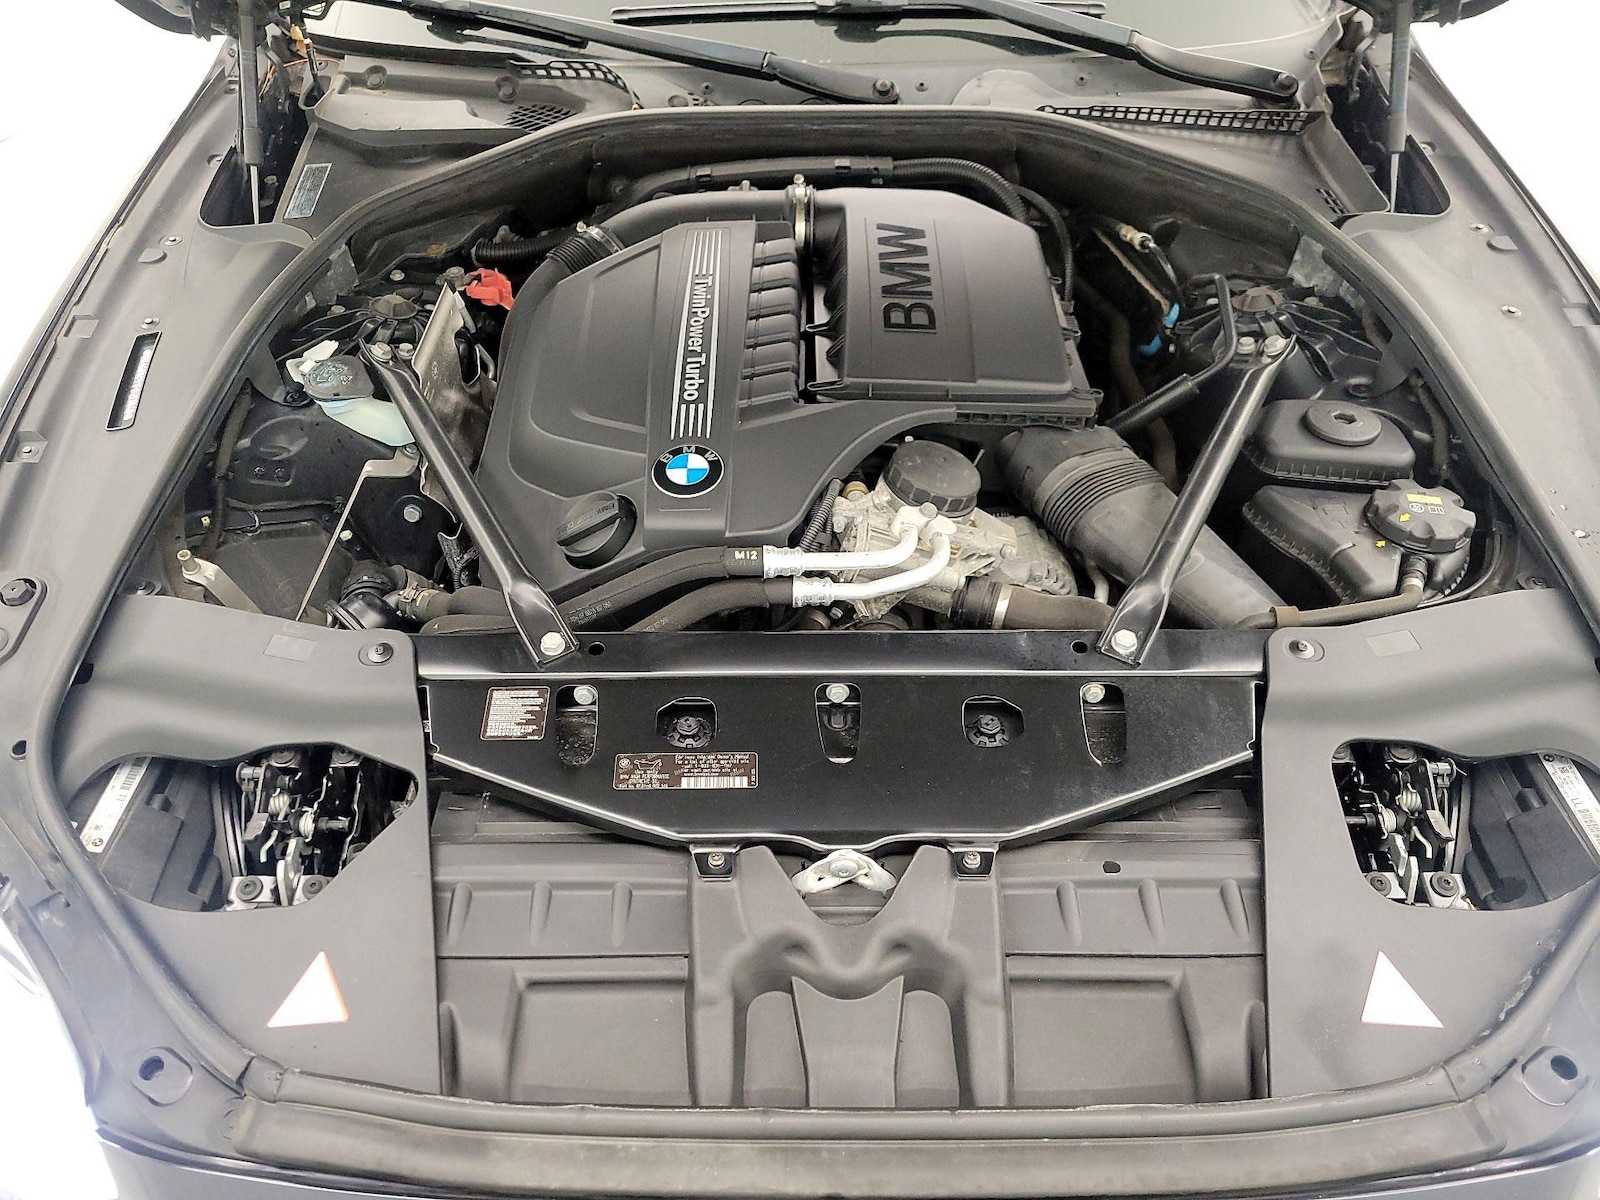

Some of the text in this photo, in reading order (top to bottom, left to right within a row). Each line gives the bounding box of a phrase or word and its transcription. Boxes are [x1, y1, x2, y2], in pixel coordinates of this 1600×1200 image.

[877, 223, 937, 334] BMW
[683, 353, 706, 400] Turbo
[659, 445, 718, 464] BMW
[734, 550, 758, 560] M12
